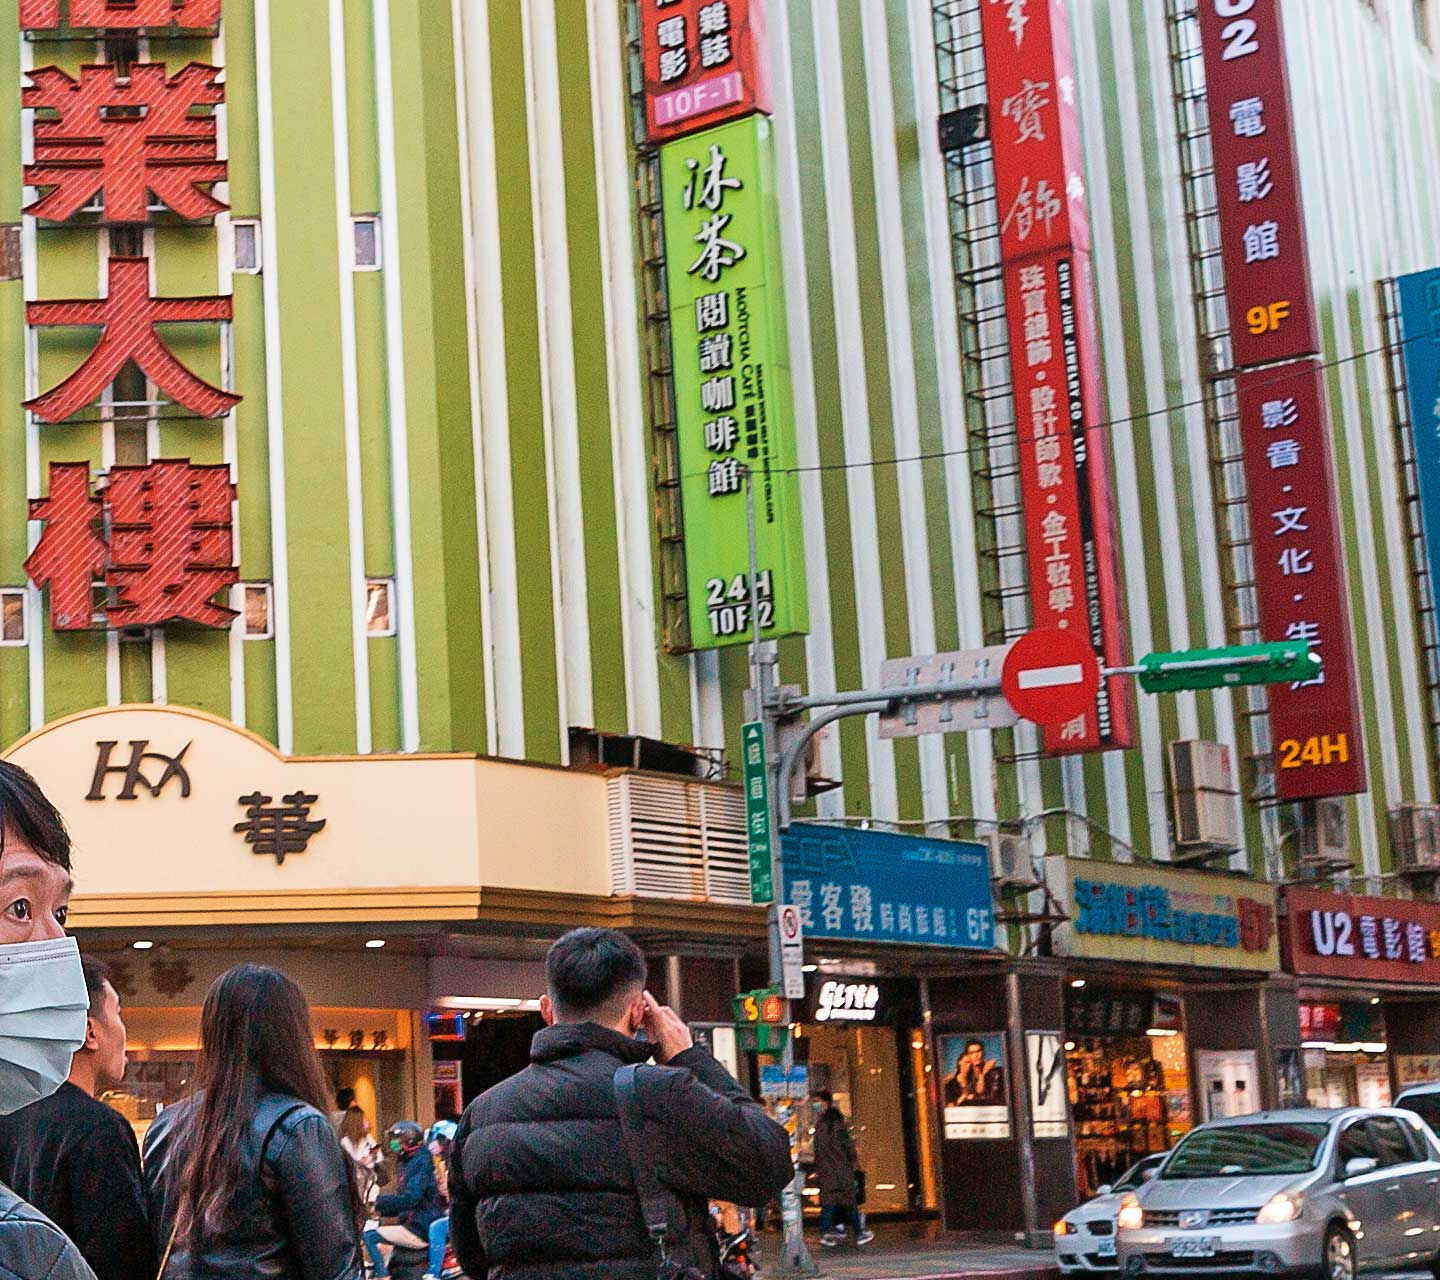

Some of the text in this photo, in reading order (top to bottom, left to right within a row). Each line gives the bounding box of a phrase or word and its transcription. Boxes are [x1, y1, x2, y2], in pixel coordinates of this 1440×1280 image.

[656, 15, 689, 83] 電影
[697, 0, 732, 70] 雜誌
[663, 75, 734, 119] 10F-1
[1228, 96, 1280, 265] 電影館
[1246, 299, 1290, 336] 9F
[1279, 730, 1350, 770] 24H
[233, 790, 327, 867] 華
[1310, 909, 1356, 958] U2
